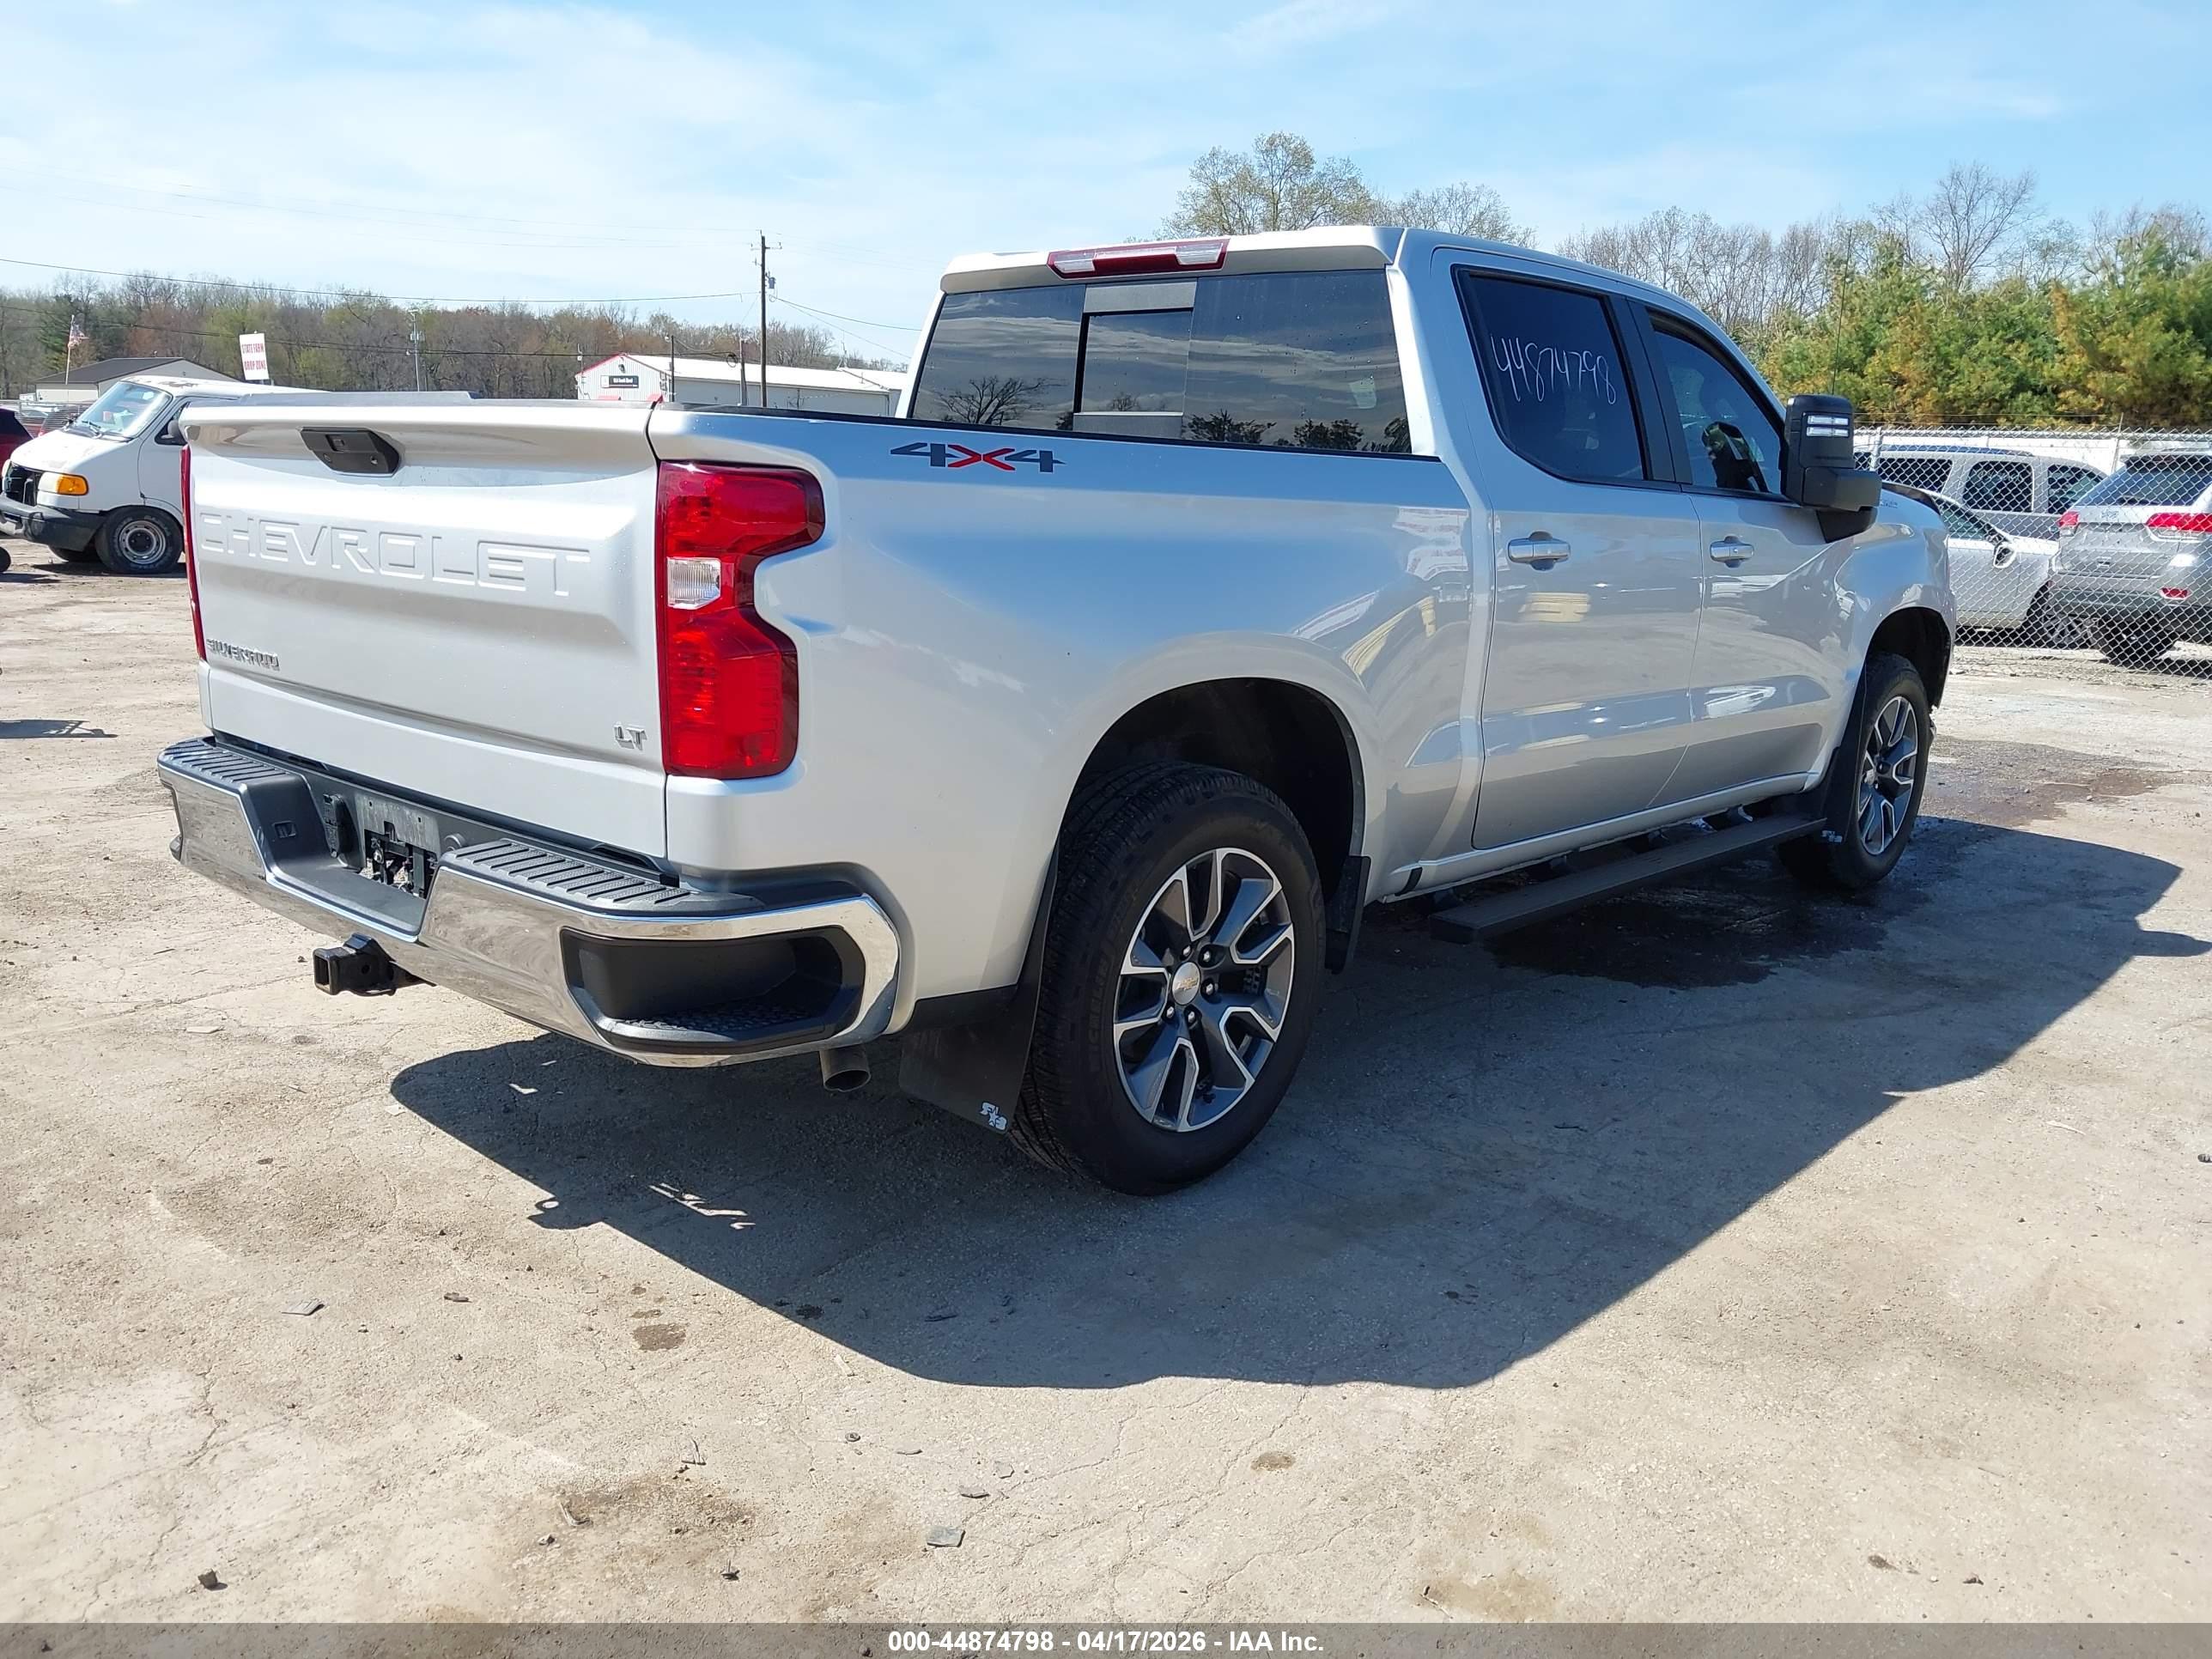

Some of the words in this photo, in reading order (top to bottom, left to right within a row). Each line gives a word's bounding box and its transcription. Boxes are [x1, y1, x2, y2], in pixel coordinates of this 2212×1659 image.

[1490, 333, 1616, 404] 44874798
[200, 512, 592, 598] CHEVROLET
[613, 725, 647, 751] LT
